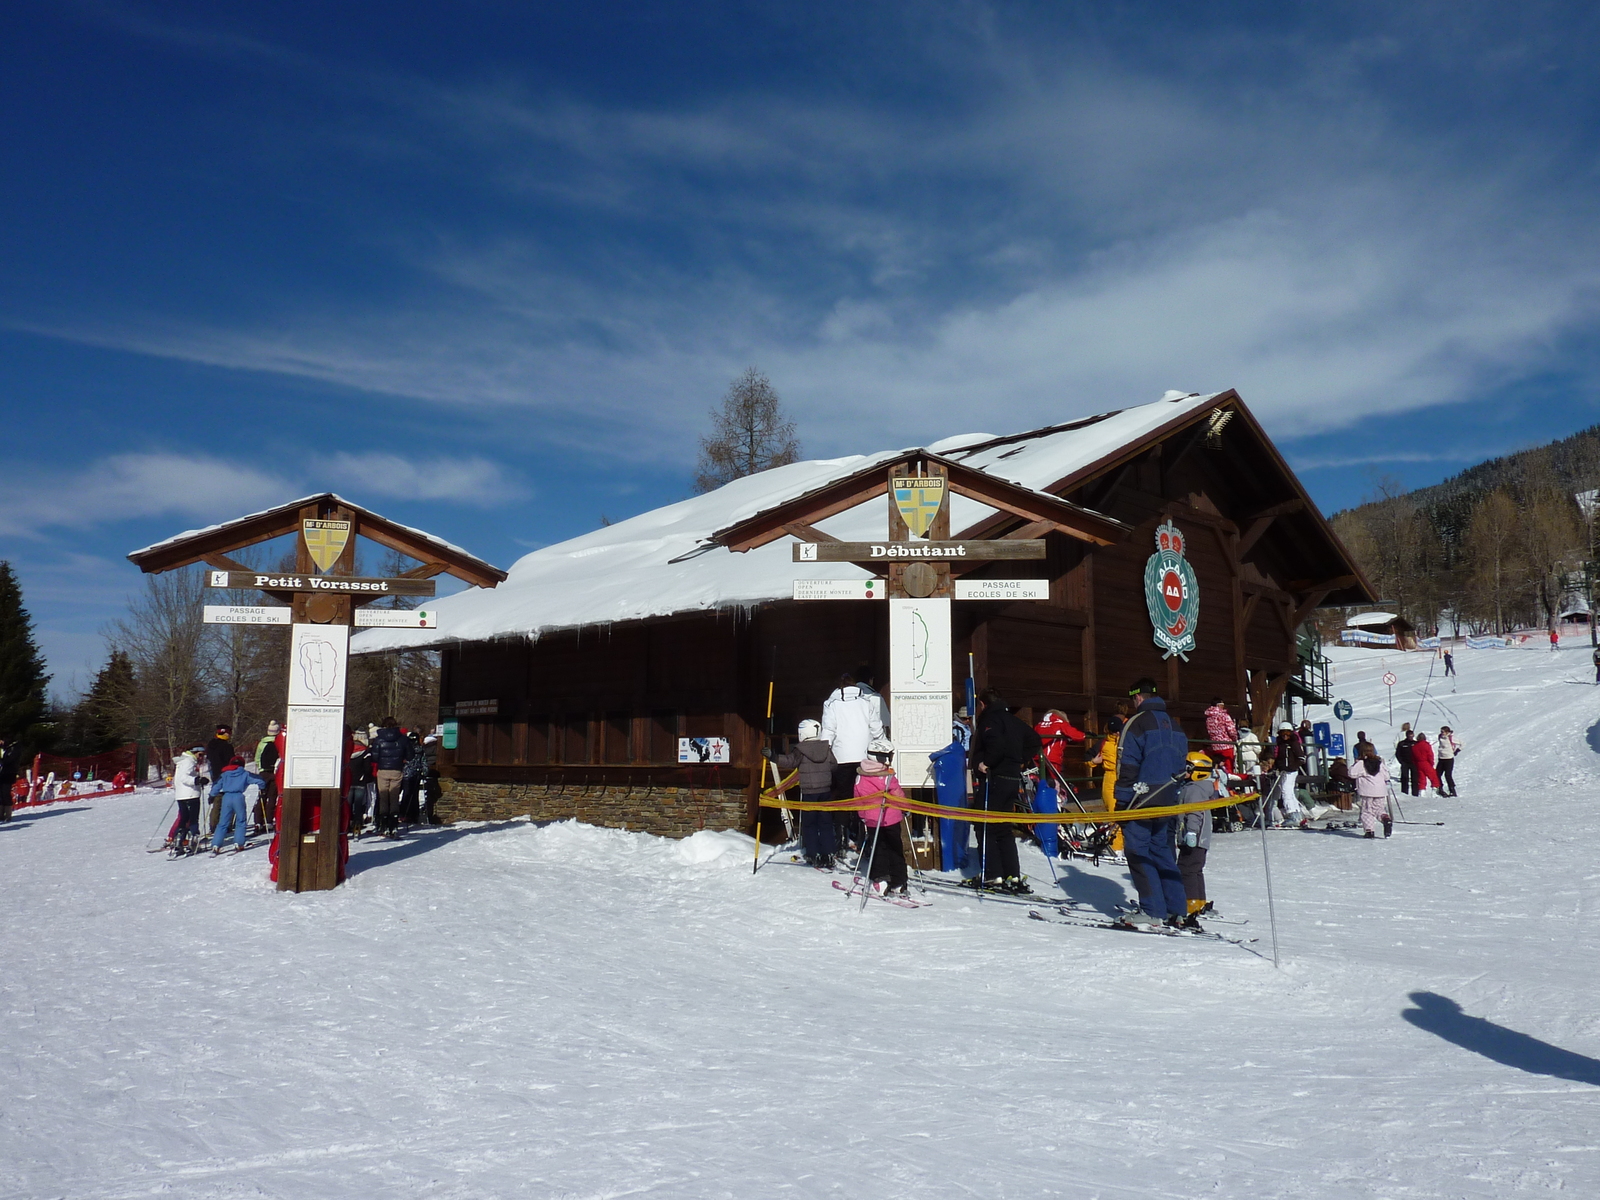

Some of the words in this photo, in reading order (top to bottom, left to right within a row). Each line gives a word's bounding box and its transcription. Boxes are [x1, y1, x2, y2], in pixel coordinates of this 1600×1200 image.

[906, 479, 941, 488] D'ARBOIS
[315, 521, 348, 530] D'ARBOIS
[869, 544, 967, 558] Débutant
[253, 575, 302, 588] Petit
[308, 577, 389, 591] Vorasset
[982, 581, 1021, 589] PASSAGE
[1165, 585, 1180, 597] AA
[229, 607, 266, 615] PASSAGE
